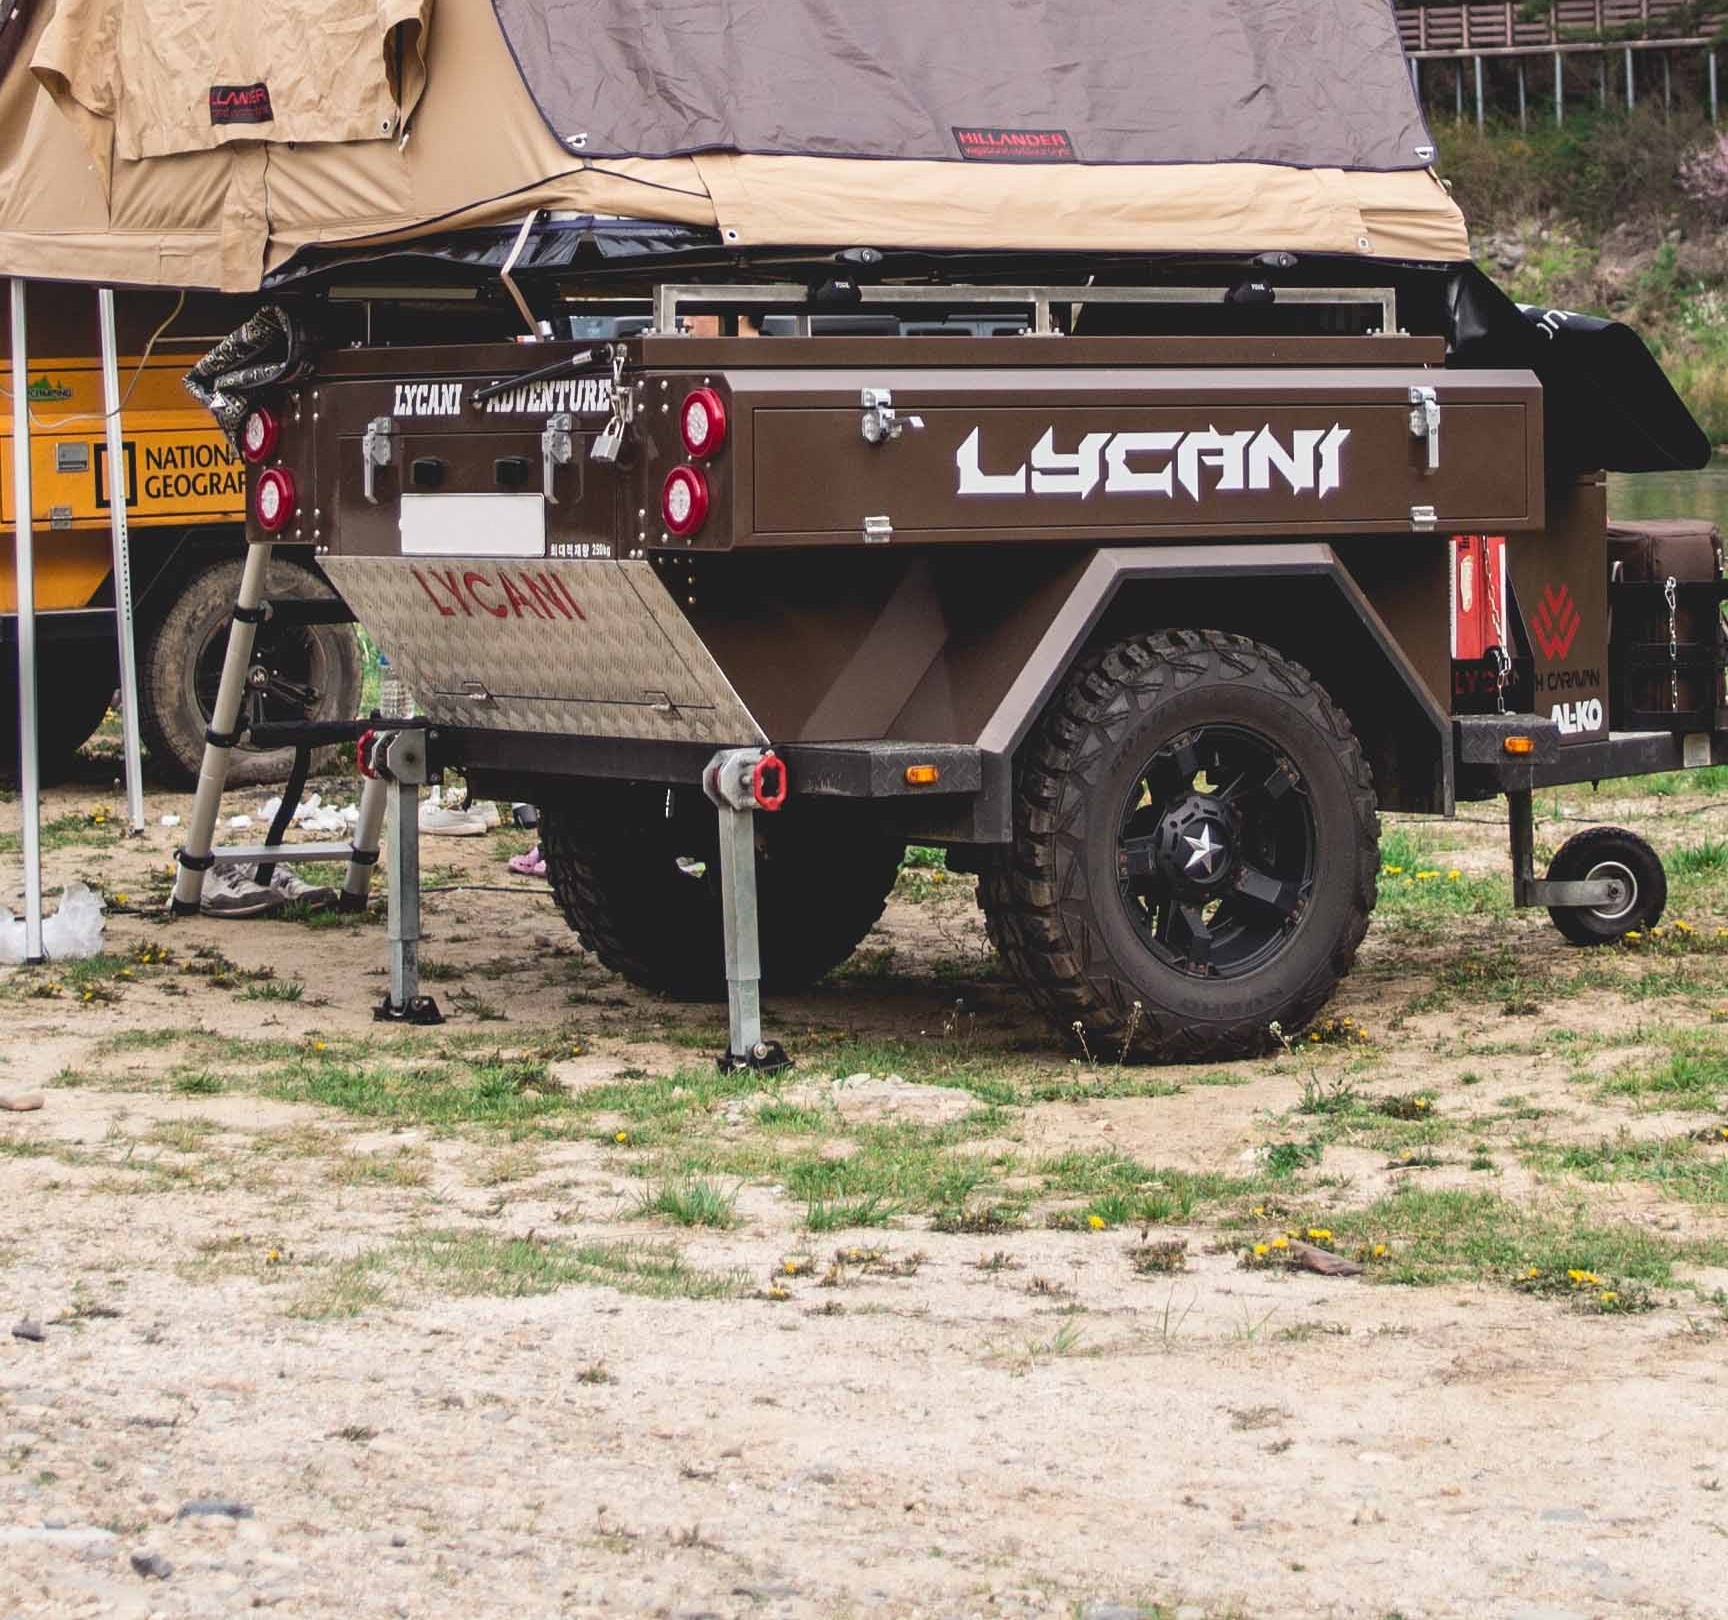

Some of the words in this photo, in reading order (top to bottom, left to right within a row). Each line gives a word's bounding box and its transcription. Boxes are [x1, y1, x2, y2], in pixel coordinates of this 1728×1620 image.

[958, 131, 1067, 147] HILLANDER
[393, 383, 463, 417] LYCANI
[486, 379, 612, 413] ADVENTURE
[145, 443, 246, 471] NATIONA
[956, 423, 1351, 502] LYCANI
[551, 543, 589, 558] 최대적재량
[592, 543, 611, 558] 250kg
[410, 565, 587, 621] LYCANI
[1547, 668, 1600, 691] CARAVAN
